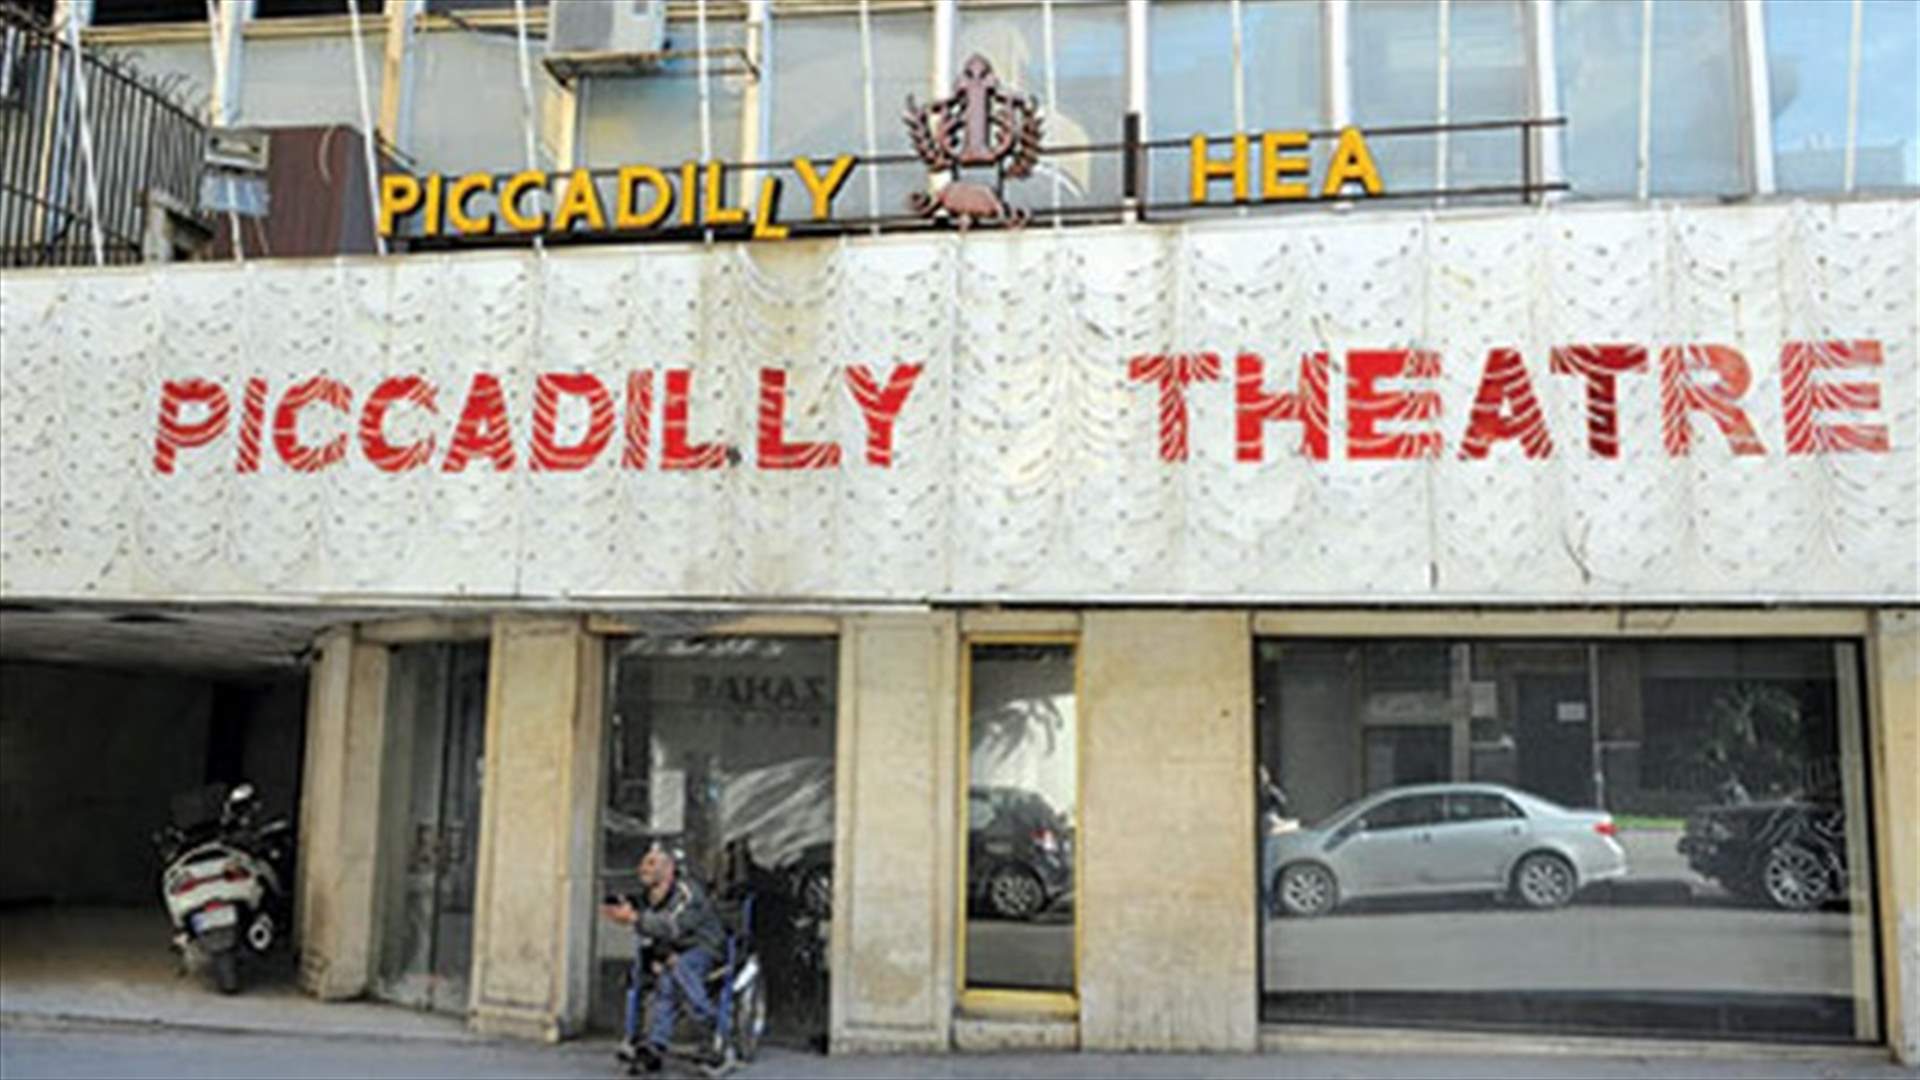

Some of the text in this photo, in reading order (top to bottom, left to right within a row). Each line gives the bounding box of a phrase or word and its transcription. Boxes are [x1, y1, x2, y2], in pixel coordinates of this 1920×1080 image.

[379, 127, 1383, 240] PICCADILLY HEA
[153, 339, 1891, 474] PICCADILLY THEATRE
